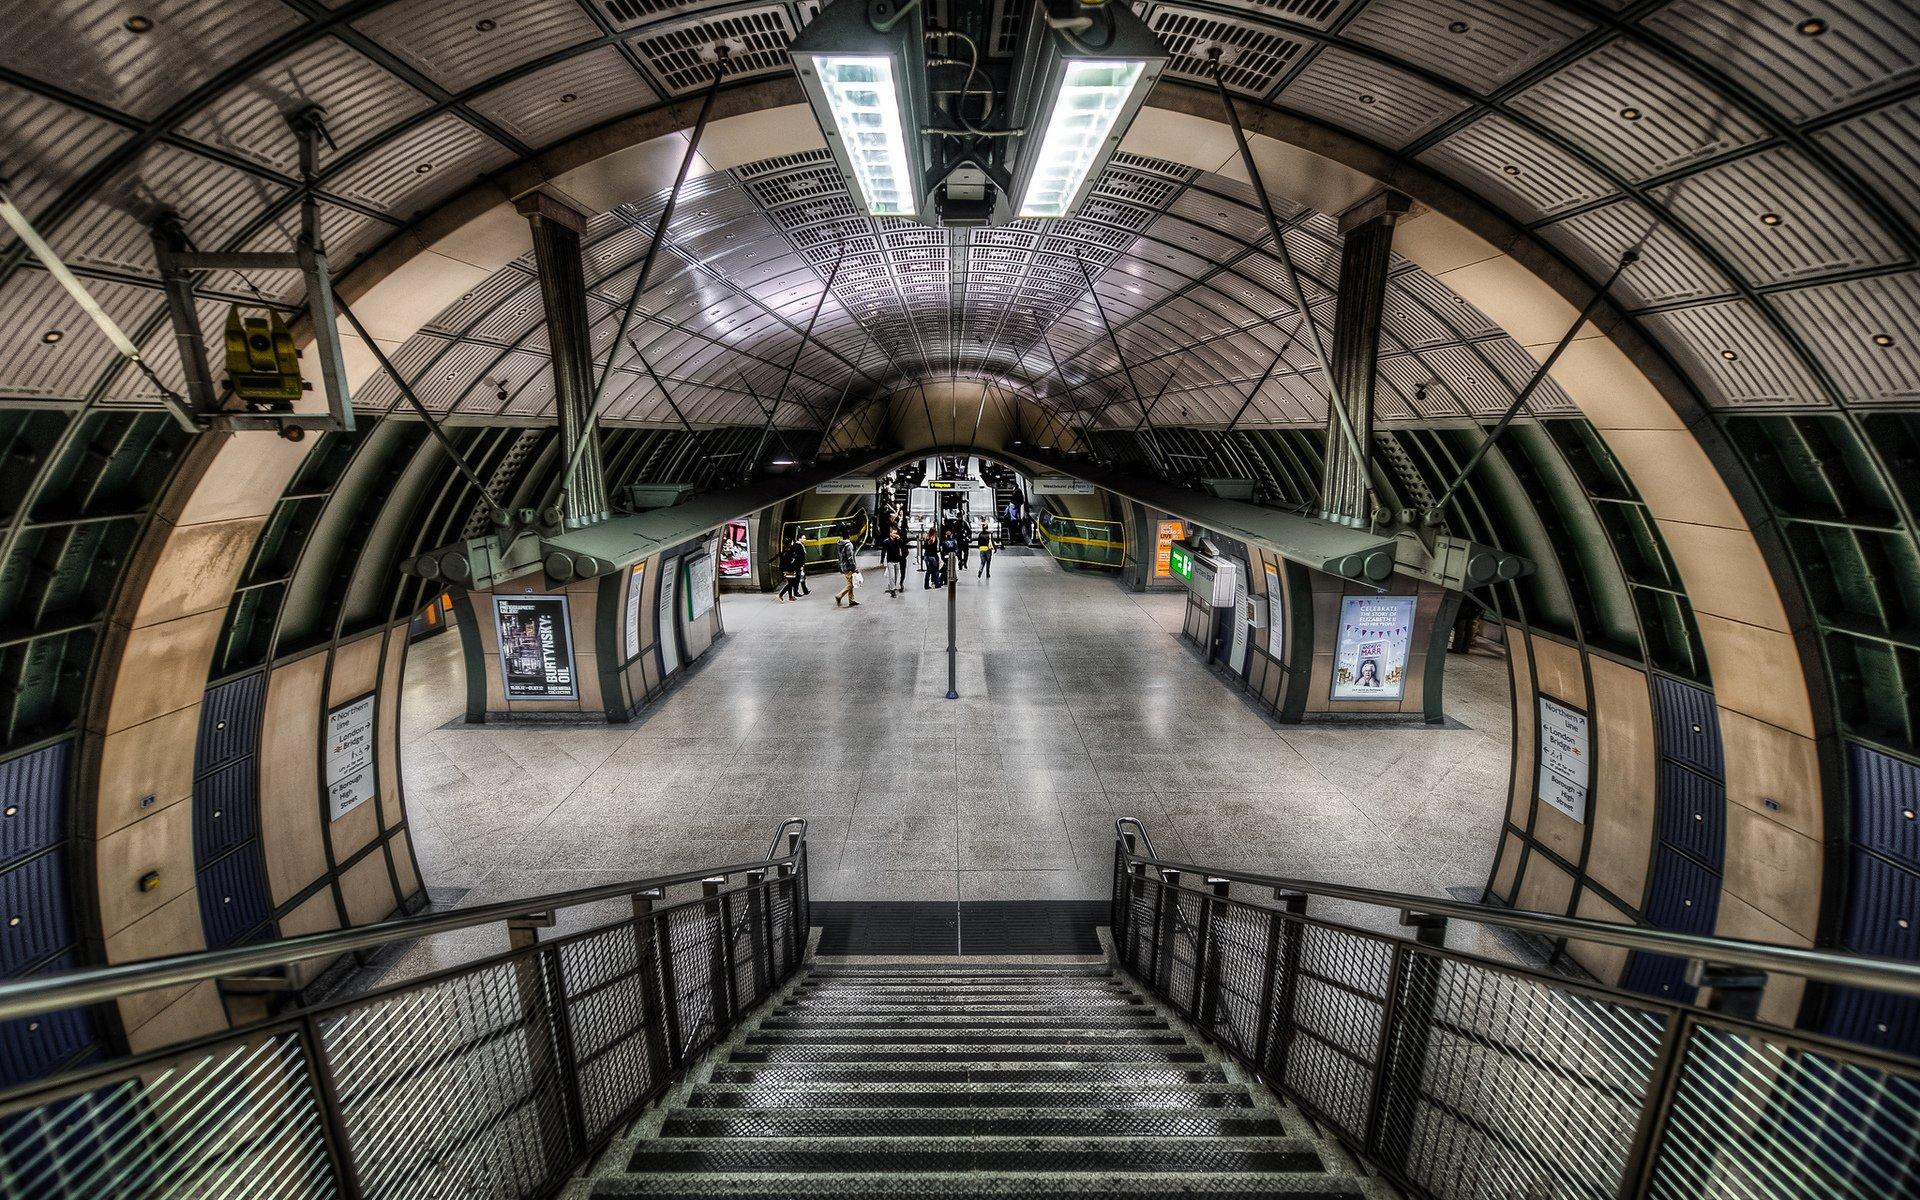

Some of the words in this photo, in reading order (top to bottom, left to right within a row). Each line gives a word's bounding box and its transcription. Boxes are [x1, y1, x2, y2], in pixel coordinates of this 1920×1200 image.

[539, 615, 558, 683] BURTYNSKY:
[1361, 648, 1382, 656] MARR
[557, 666, 571, 683] OIL
[337, 702, 369, 721] Northern
[1545, 702, 1578, 723] Northern
[336, 719, 350, 731] line
[1565, 719, 1579, 732] line
[339, 726, 364, 743] London
[343, 735, 364, 750] Bridge
[1549, 726, 1576, 745] London
[1550, 735, 1571, 752] Bridge
[338, 774, 362, 791] Borough
[1551, 774, 1575, 794] Borough
[339, 788, 353, 800] High
[340, 795, 357, 810] Street
[1561, 789, 1575, 802] High
[1555, 796, 1574, 812] Street
